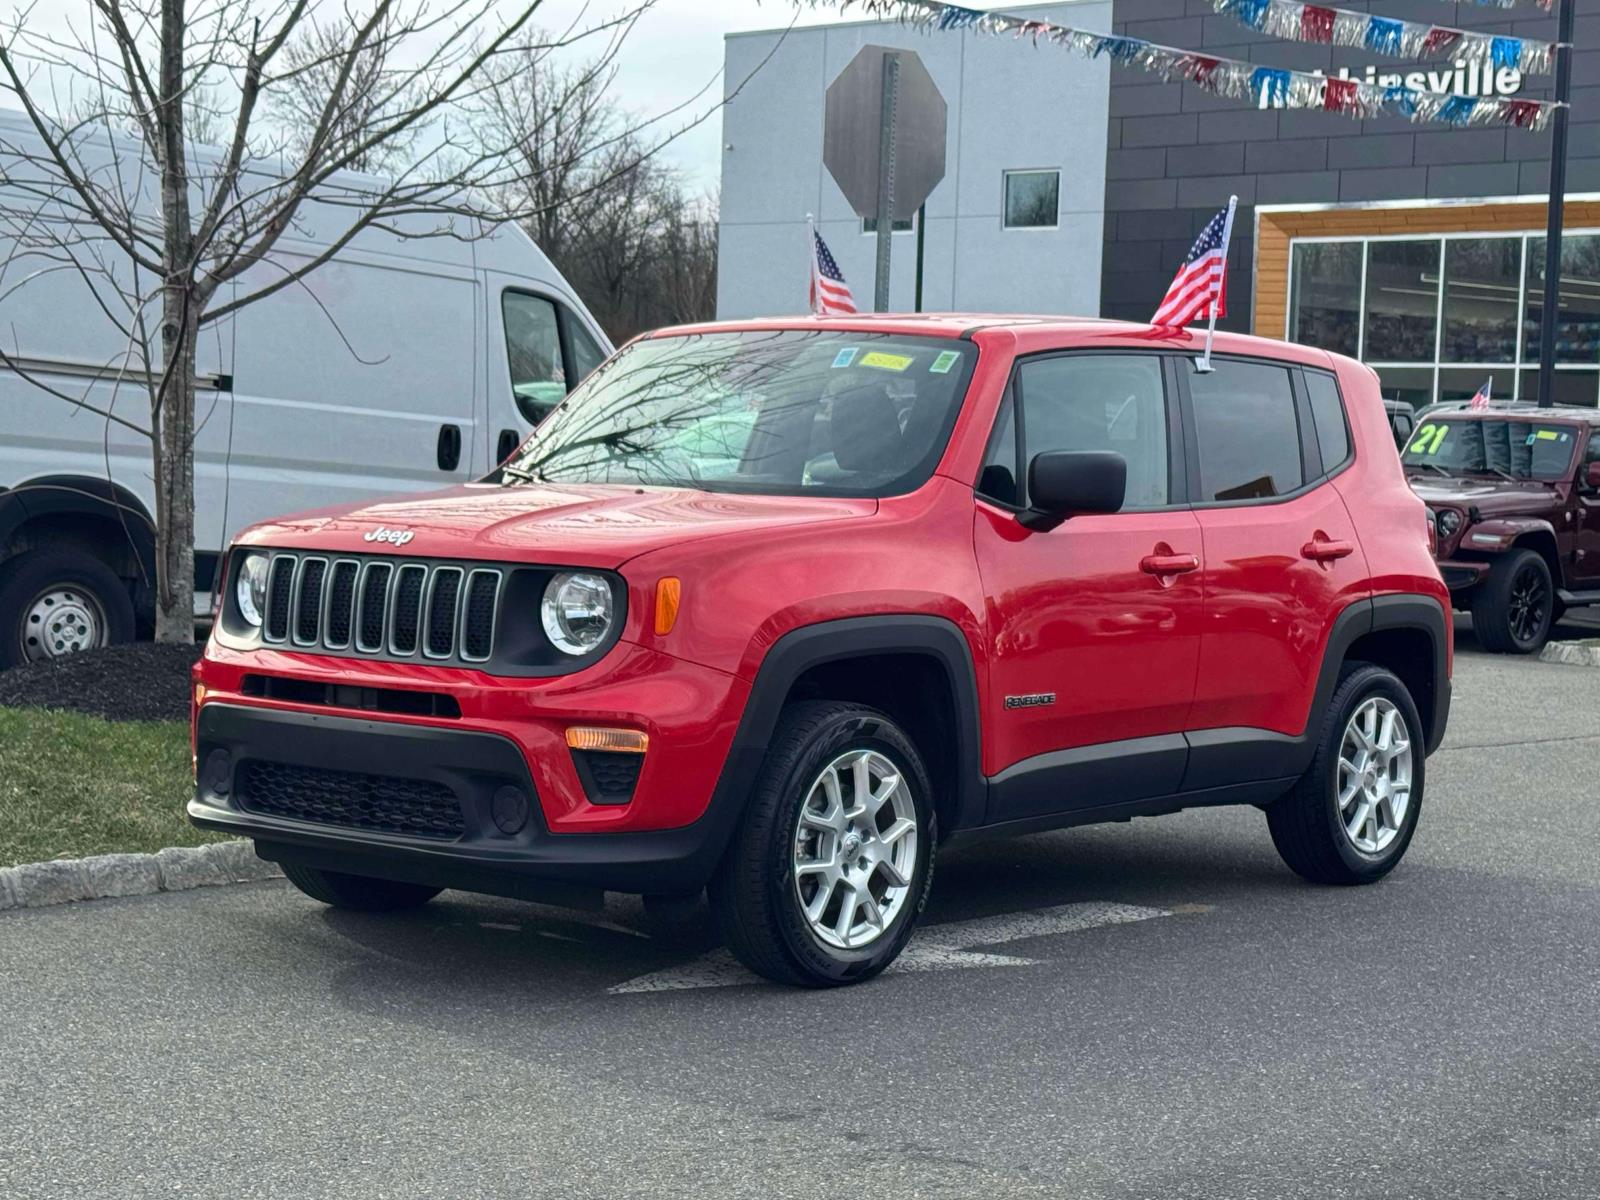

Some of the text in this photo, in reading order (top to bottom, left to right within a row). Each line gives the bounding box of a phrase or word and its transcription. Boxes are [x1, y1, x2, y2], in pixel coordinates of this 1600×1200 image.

[1258, 58, 1522, 110] insville
[1410, 423, 1449, 455] 21
[364, 526, 415, 547] Jeep
